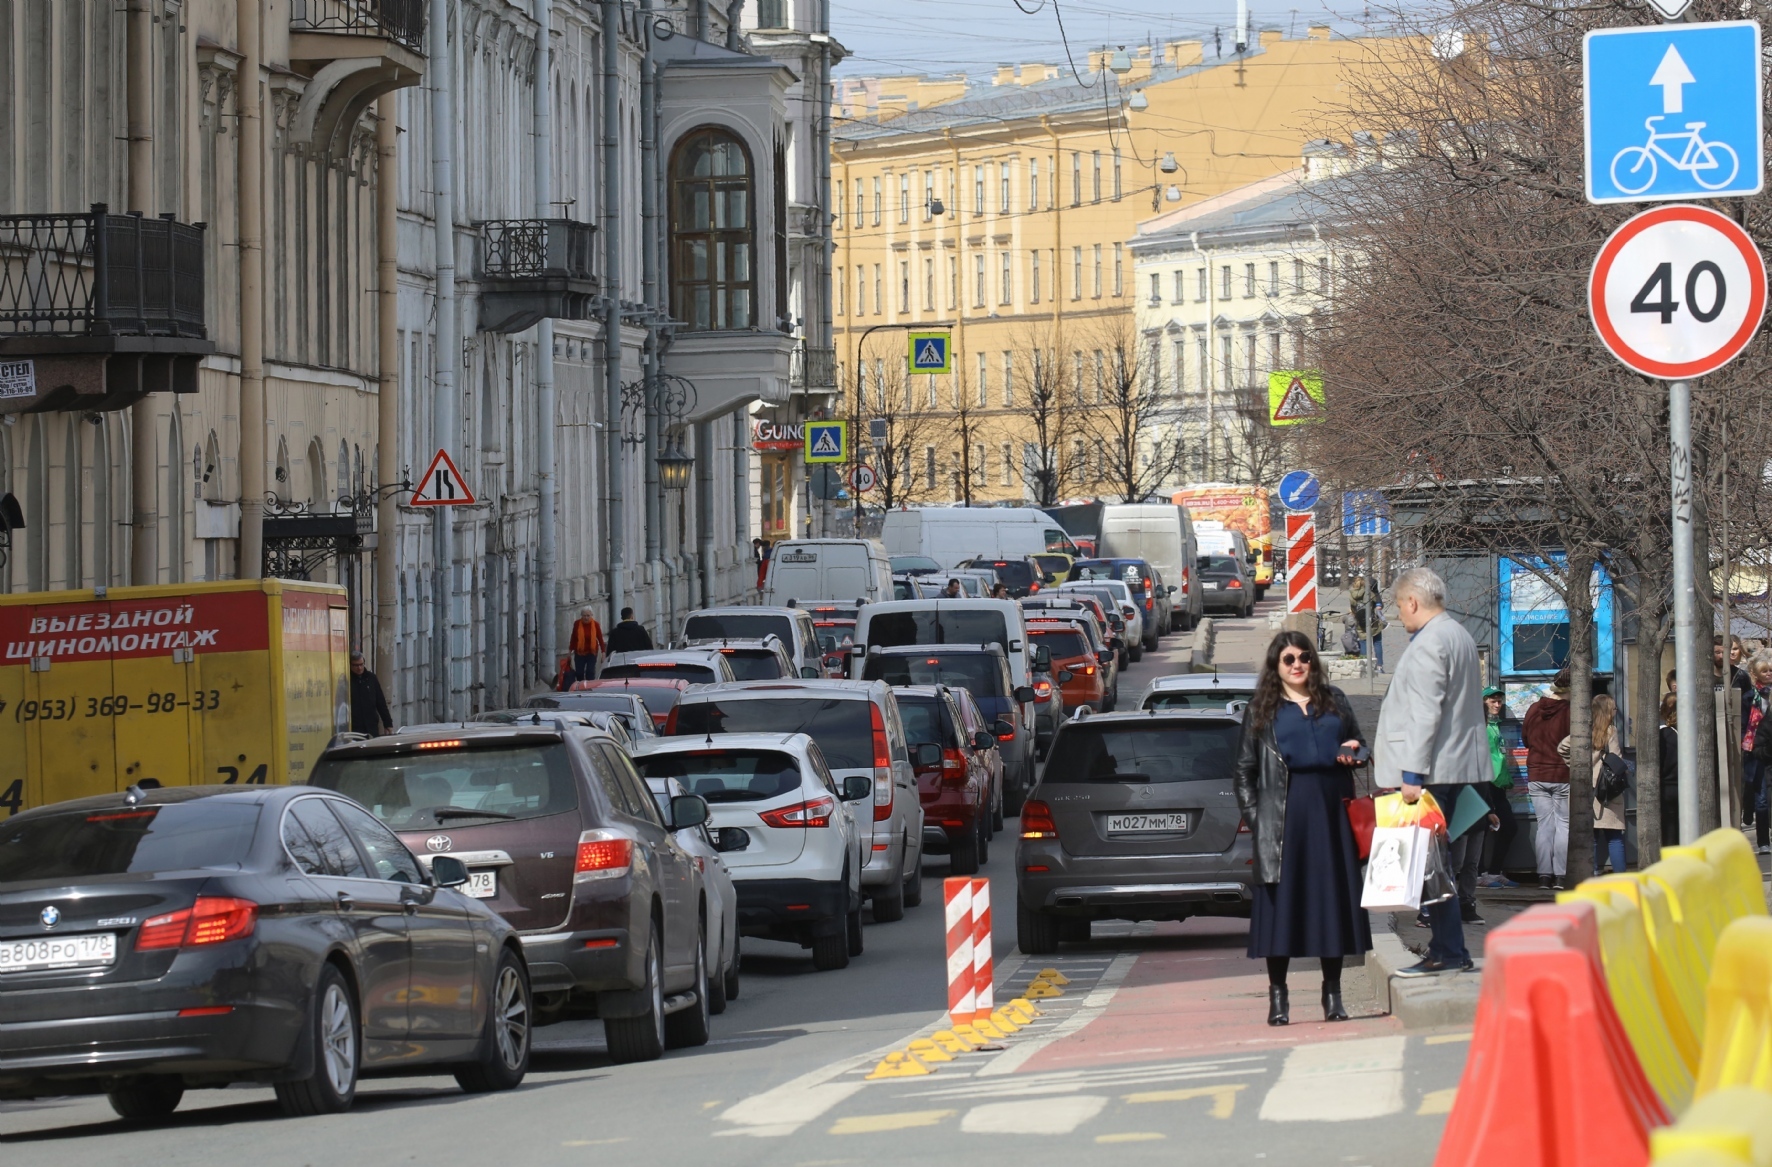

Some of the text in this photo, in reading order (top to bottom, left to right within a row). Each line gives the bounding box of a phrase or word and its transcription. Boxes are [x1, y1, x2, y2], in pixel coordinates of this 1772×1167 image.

[1629, 259, 1728, 325] 40
[29, 604, 195, 634] ВЫЕЗДНОЙ
[5, 629, 220, 659] ШИНОМОНТАЖ
[15, 696, 76, 724] (953)
[85, 689, 220, 718] 369-98-33
[1113, 814, 1182, 830] М027ММ 78
[540, 851, 554, 859] V6
[0, 936, 108, 962] В808РО 178
